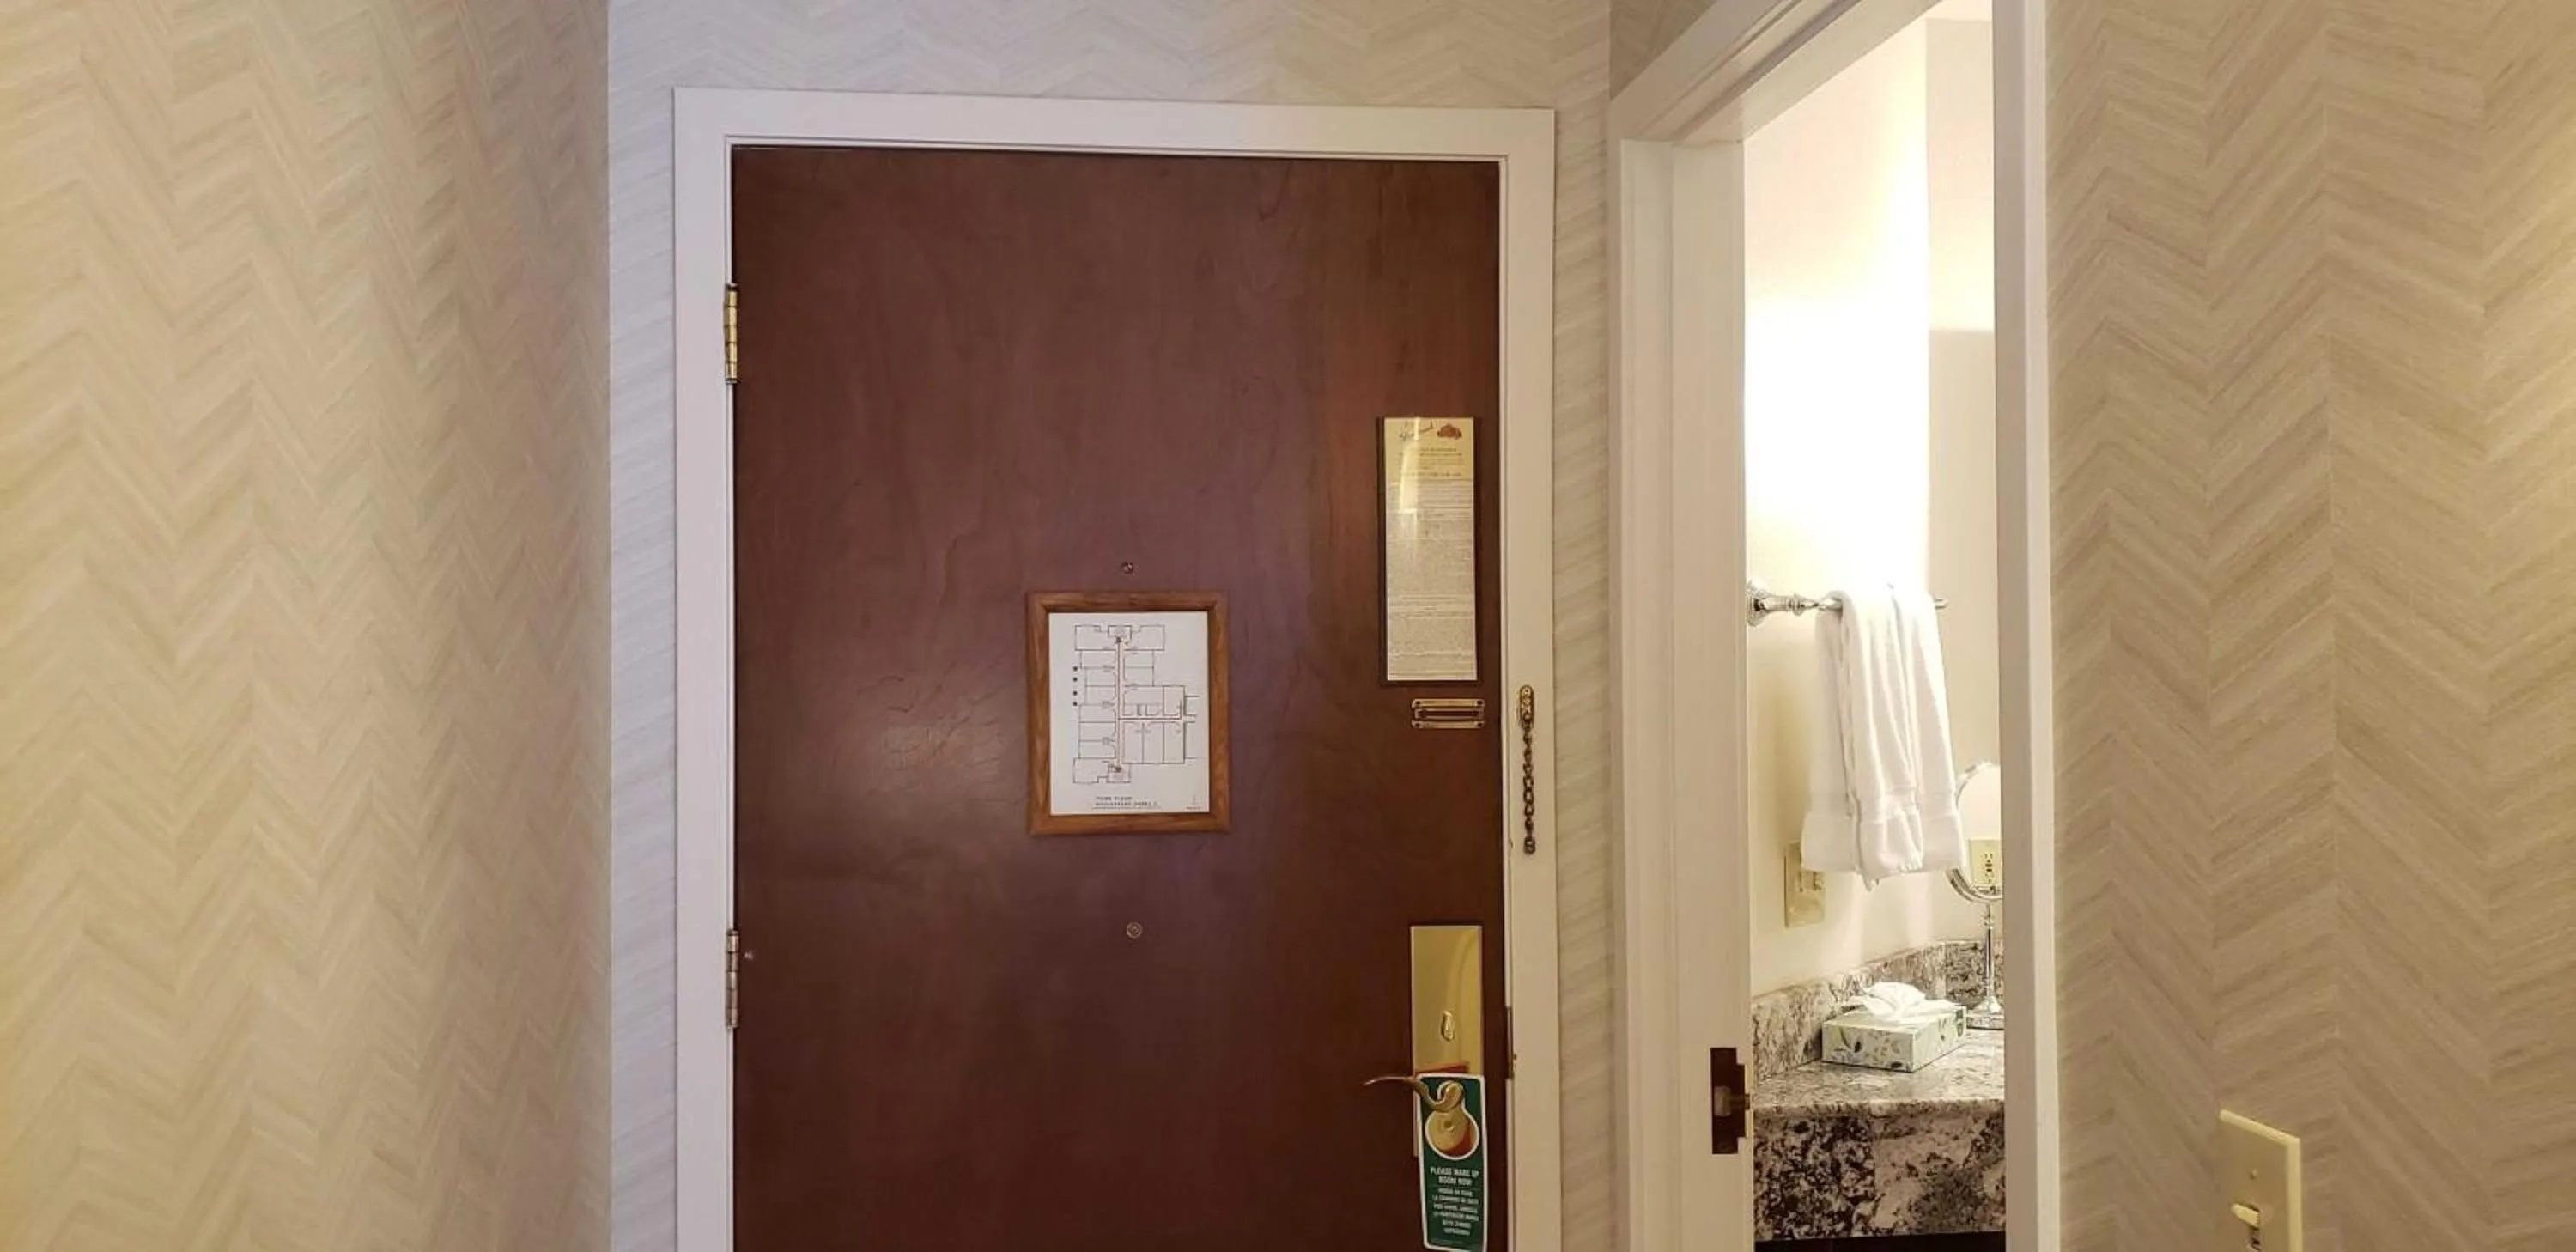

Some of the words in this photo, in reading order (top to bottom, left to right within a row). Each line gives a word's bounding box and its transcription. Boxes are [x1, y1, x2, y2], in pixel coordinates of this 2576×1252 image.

[1430, 1166, 1452, 1176] PLEASE
[1454, 1168, 1471, 1177] MAKE
[1471, 1170, 1479, 1178] UP
[1438, 1176, 1457, 1184] ROOM
[1457, 1177, 1473, 1186] NOW
